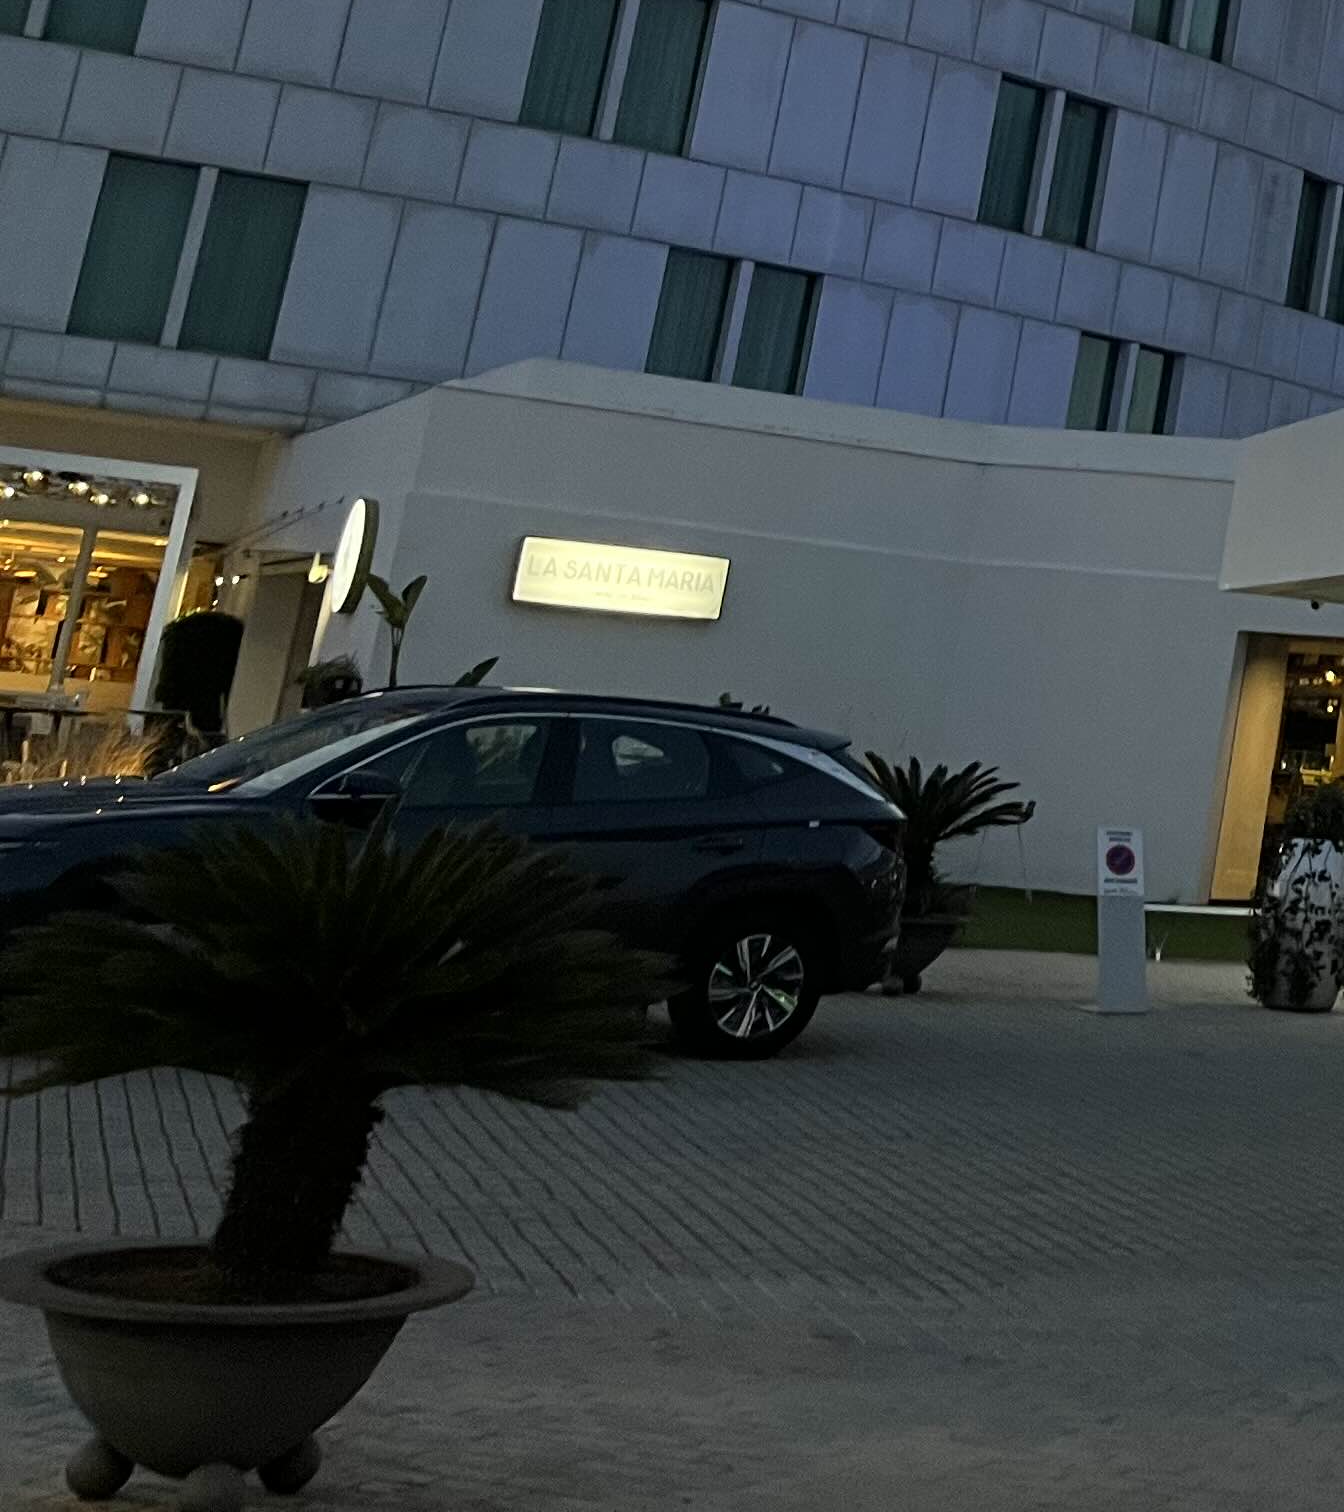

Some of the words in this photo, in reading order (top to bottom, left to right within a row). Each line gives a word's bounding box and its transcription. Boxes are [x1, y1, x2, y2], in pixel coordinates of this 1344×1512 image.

[527, 555, 557, 577] LA
[563, 559, 641, 586] SANTA
[646, 567, 715, 594] MARIA
